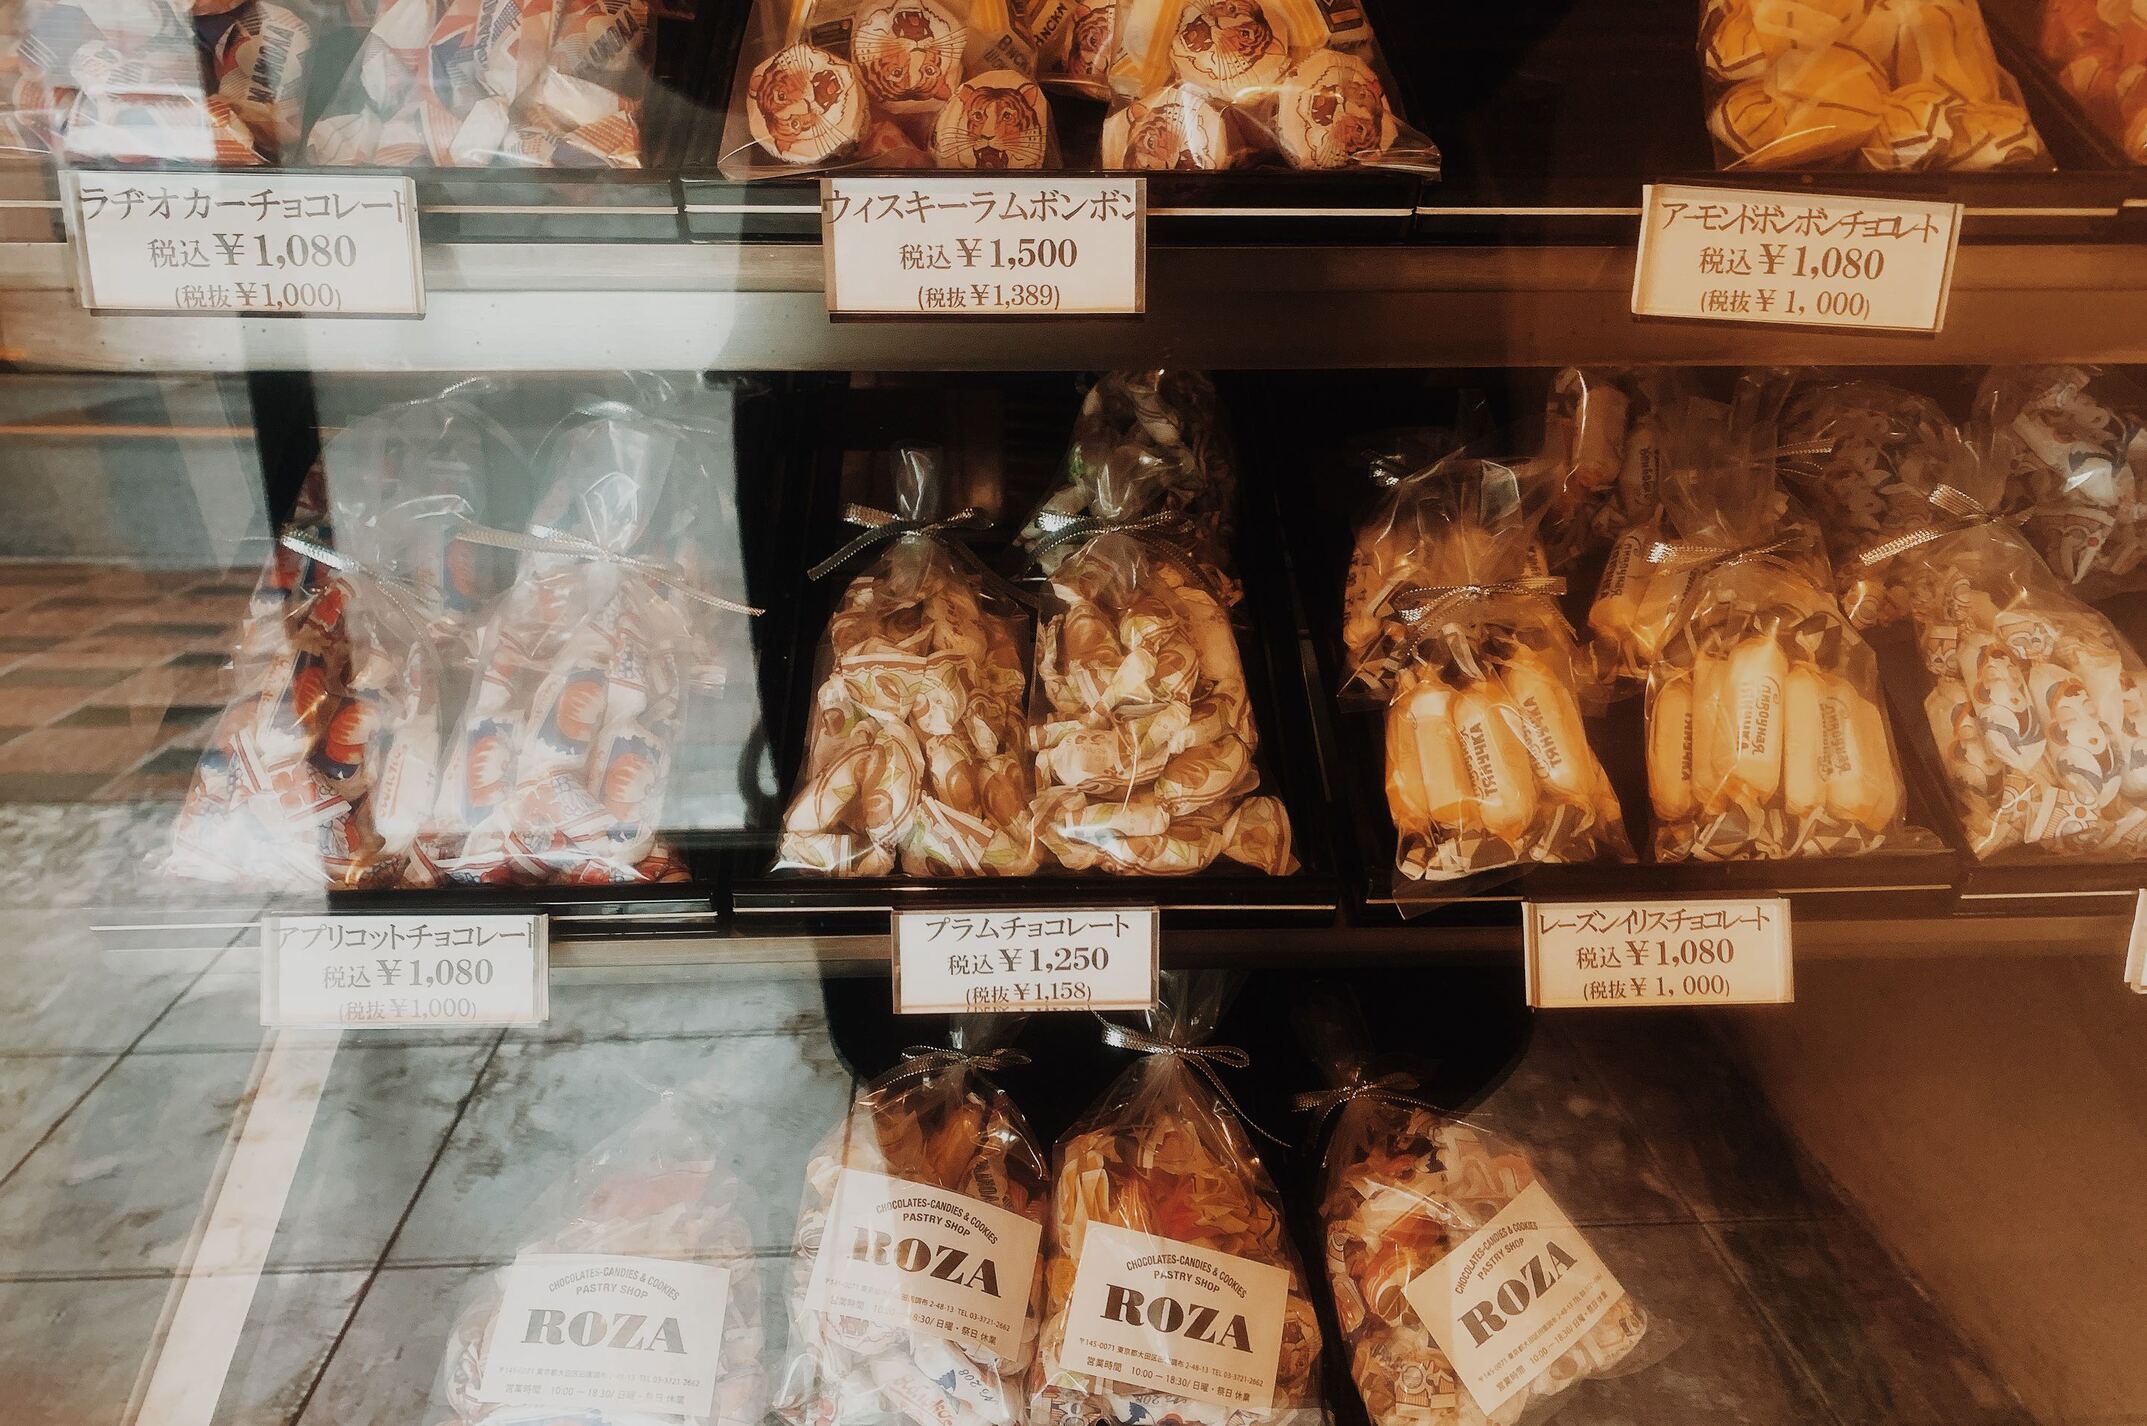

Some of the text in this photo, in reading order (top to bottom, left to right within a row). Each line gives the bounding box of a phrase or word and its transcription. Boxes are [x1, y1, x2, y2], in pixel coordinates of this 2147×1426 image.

[925, 913, 1130, 942] プラムチョコレート
[903, 1212, 971, 1238] PASTRY SHOP
[962, 1212, 970, 1221] &
[970, 1215, 999, 1245] COOKIES
[1513, 1221, 1538, 1232] COOKIES
[849, 1226, 1001, 1298] ROZA
[1477, 1237, 1525, 1280] PASTRY SHOP
[576, 1283, 649, 1299] PASTRY SHOP
[648, 1276, 680, 1300] COOKIES
[1154, 1270, 1220, 1293] PASTRY SHOP
[1212, 1267, 1219, 1276] &
[1219, 1271, 1248, 1299] COOKIES
[1457, 1241, 1578, 1349] ROZA
[957, 1308, 969, 1318] TEL
[1100, 1283, 1253, 1354] ROZA
[520, 1308, 688, 1354] ROZA
[1087, 1356, 1122, 1373] 営業時間
[1131, 1366, 1153, 1379] 10:00
[1212, 1369, 1223, 1377] TEL
